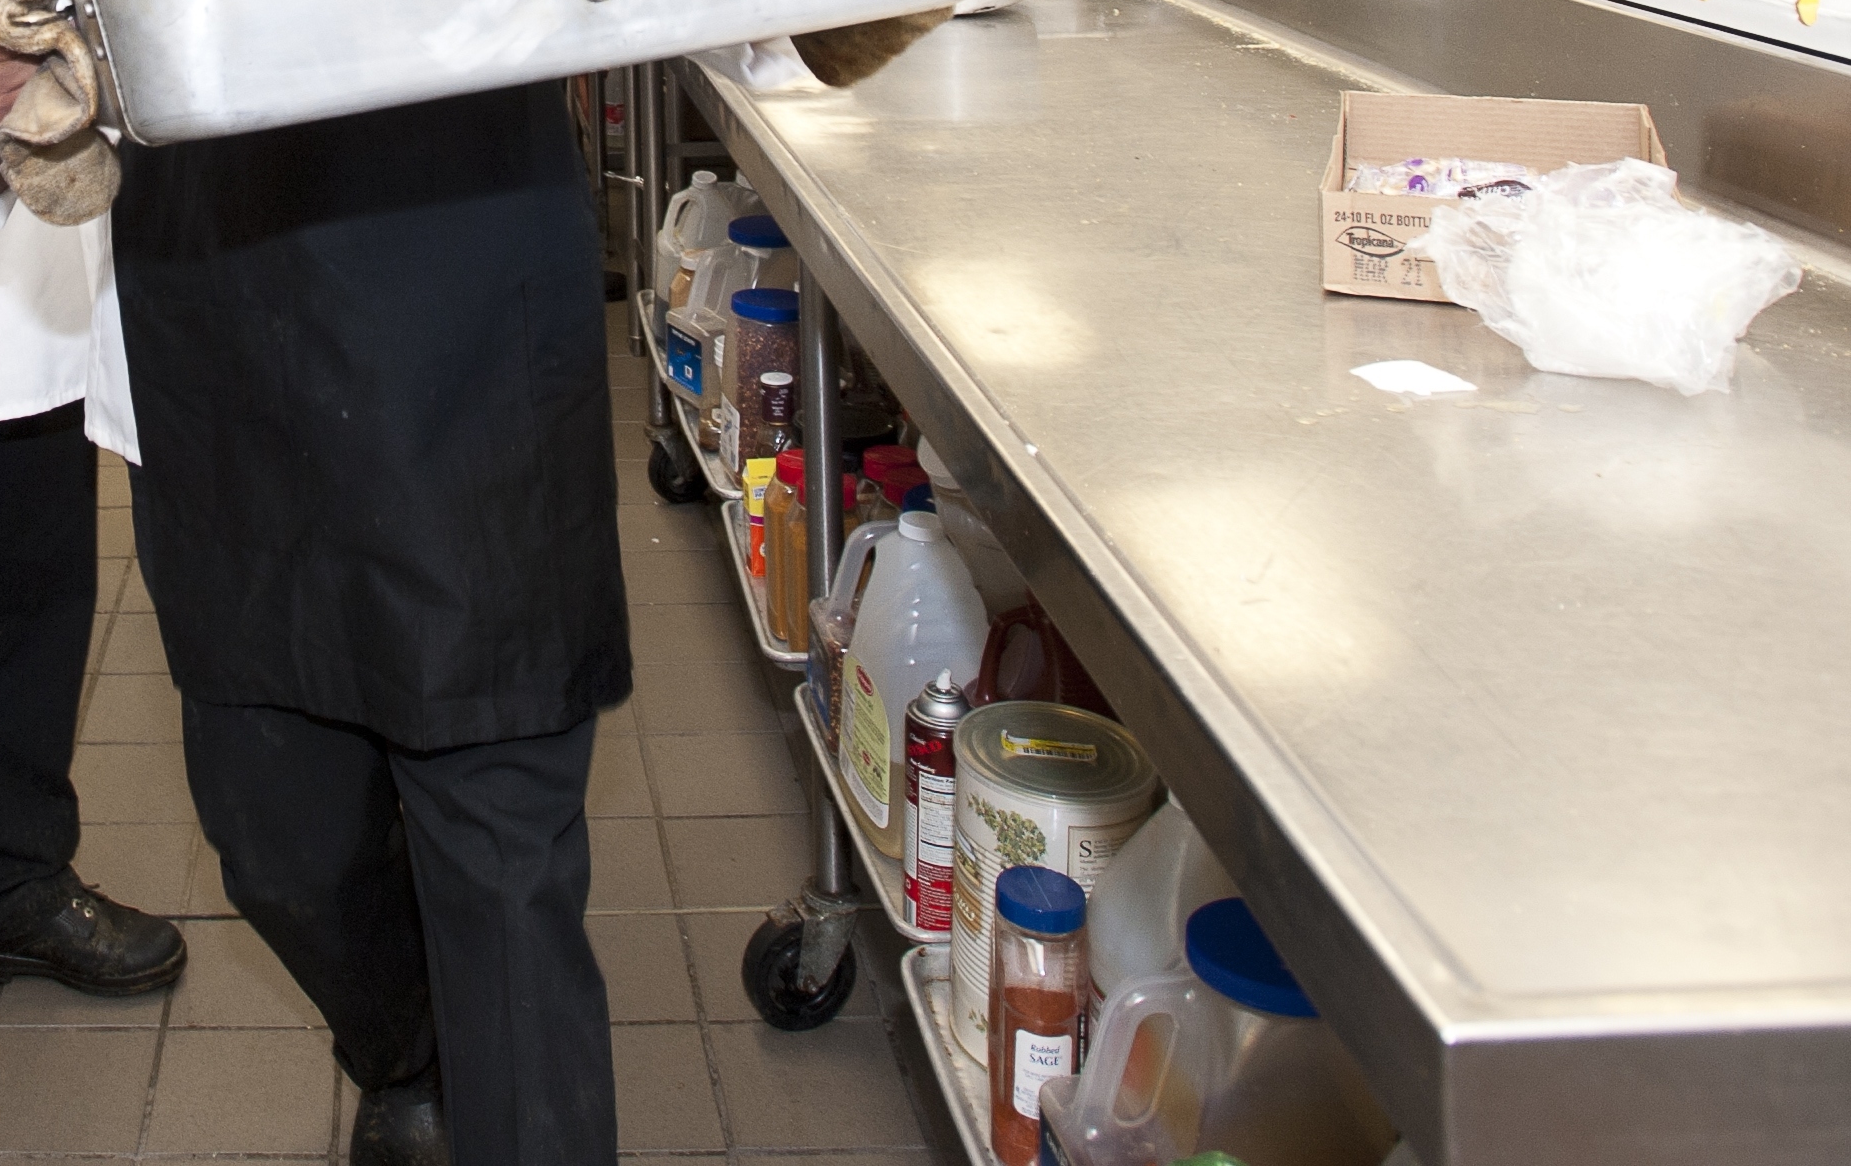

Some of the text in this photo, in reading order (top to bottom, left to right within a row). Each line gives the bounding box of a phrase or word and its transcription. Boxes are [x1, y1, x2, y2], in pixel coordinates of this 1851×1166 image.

[1334, 210, 1362, 224] 24-10
[1365, 212, 1376, 224] FL
[1380, 213, 1393, 226] OZ
[1346, 232, 1396, 249] Tropicana
[1030, 1043, 1061, 1055] Rubbed
[1029, 1053, 1060, 1066] SAGE
